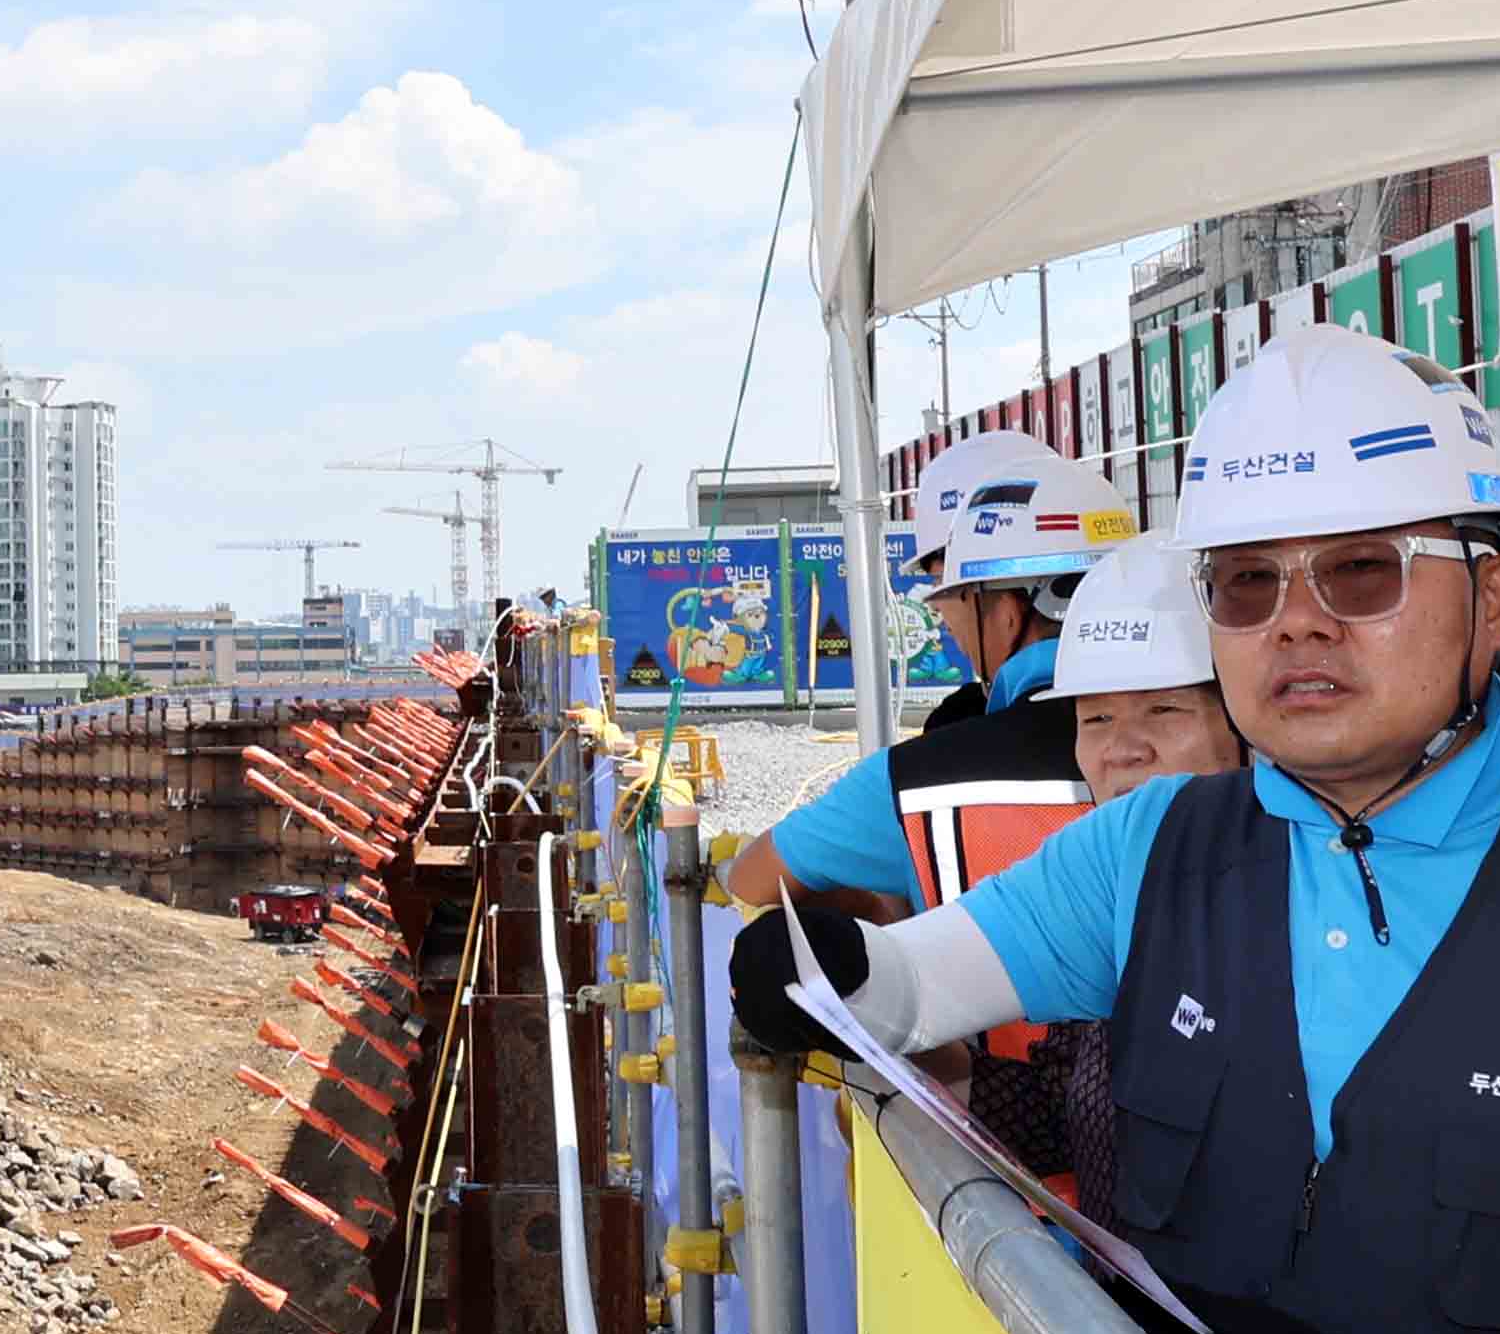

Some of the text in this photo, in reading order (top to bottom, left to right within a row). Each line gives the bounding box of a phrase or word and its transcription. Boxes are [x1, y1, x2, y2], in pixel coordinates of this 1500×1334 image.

[1221, 450, 1317, 483] 두산건설
[617, 548, 646, 564] 내가
[1078, 619, 1150, 643] 두산건설
